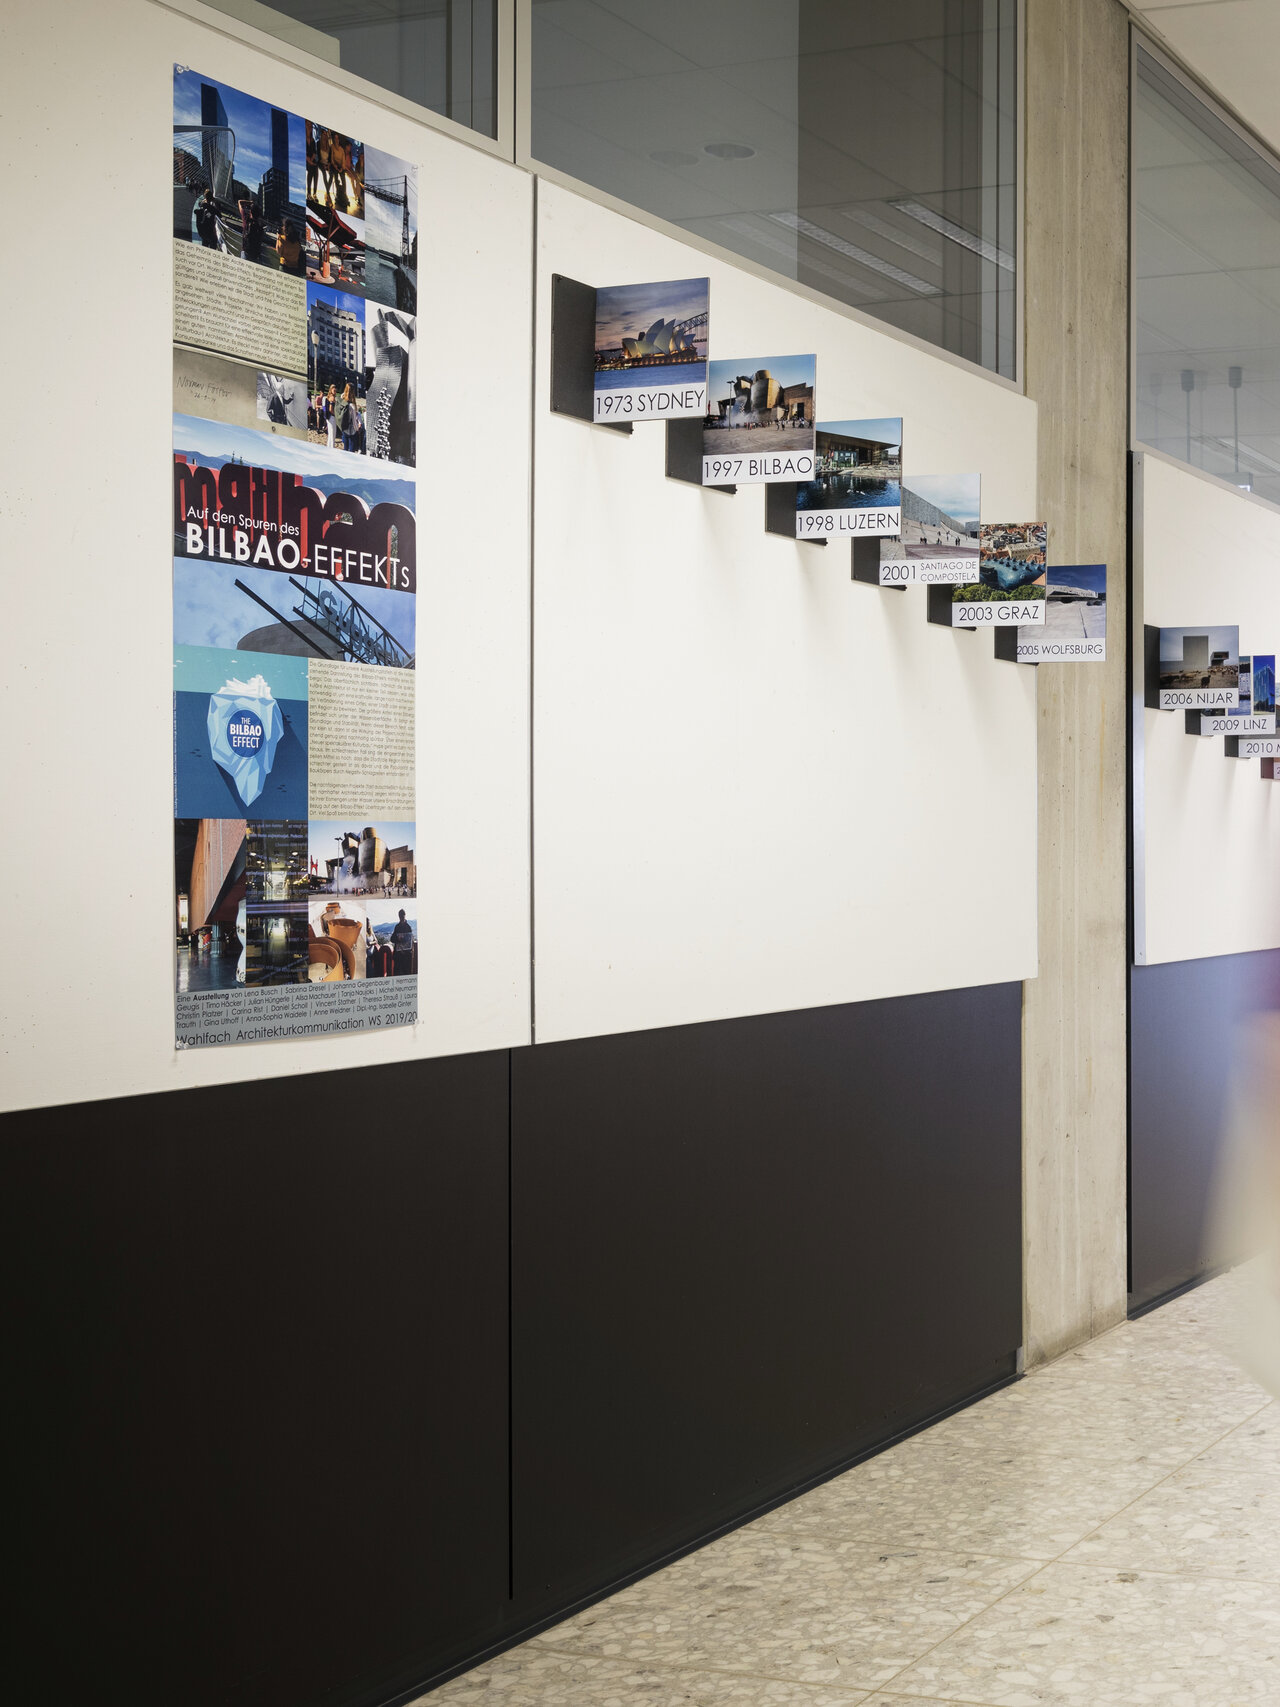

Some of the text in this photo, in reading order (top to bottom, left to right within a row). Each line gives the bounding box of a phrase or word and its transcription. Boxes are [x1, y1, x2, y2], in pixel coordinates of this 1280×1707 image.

[596, 390, 704, 414] 1973 SYDNEY
[704, 456, 812, 478] 1997 BILBAO
[187, 506, 300, 536] Auf den Spuren des
[798, 512, 899, 532] 1998 LUZERN
[882, 564, 916, 580] 2001
[920, 561, 976, 571] SANTIAGO DE
[920, 572, 976, 582] COMPOSTELA
[959, 606, 1039, 621] 2003 GRAZ
[1016, 644, 1103, 656] 2005 WOLFSBURG
[1164, 693, 1233, 704] 2006 NIJAR
[230, 724, 262, 736] BILBAO
[1212, 719, 1266, 730] 2009 LINZ
[233, 736, 260, 749] EFFECT
[1246, 743, 1273, 754] 2010
[193, 992, 229, 1002] Ausstellung
[285, 985, 306, 993] Sabrina
[308, 991, 335, 999] Machauer
[315, 999, 335, 1007] Vincent
[236, 1016, 363, 1040] Architekturkommunikation
[368, 1015, 381, 1026] WS
[385, 1011, 416, 1024] 2019/20
